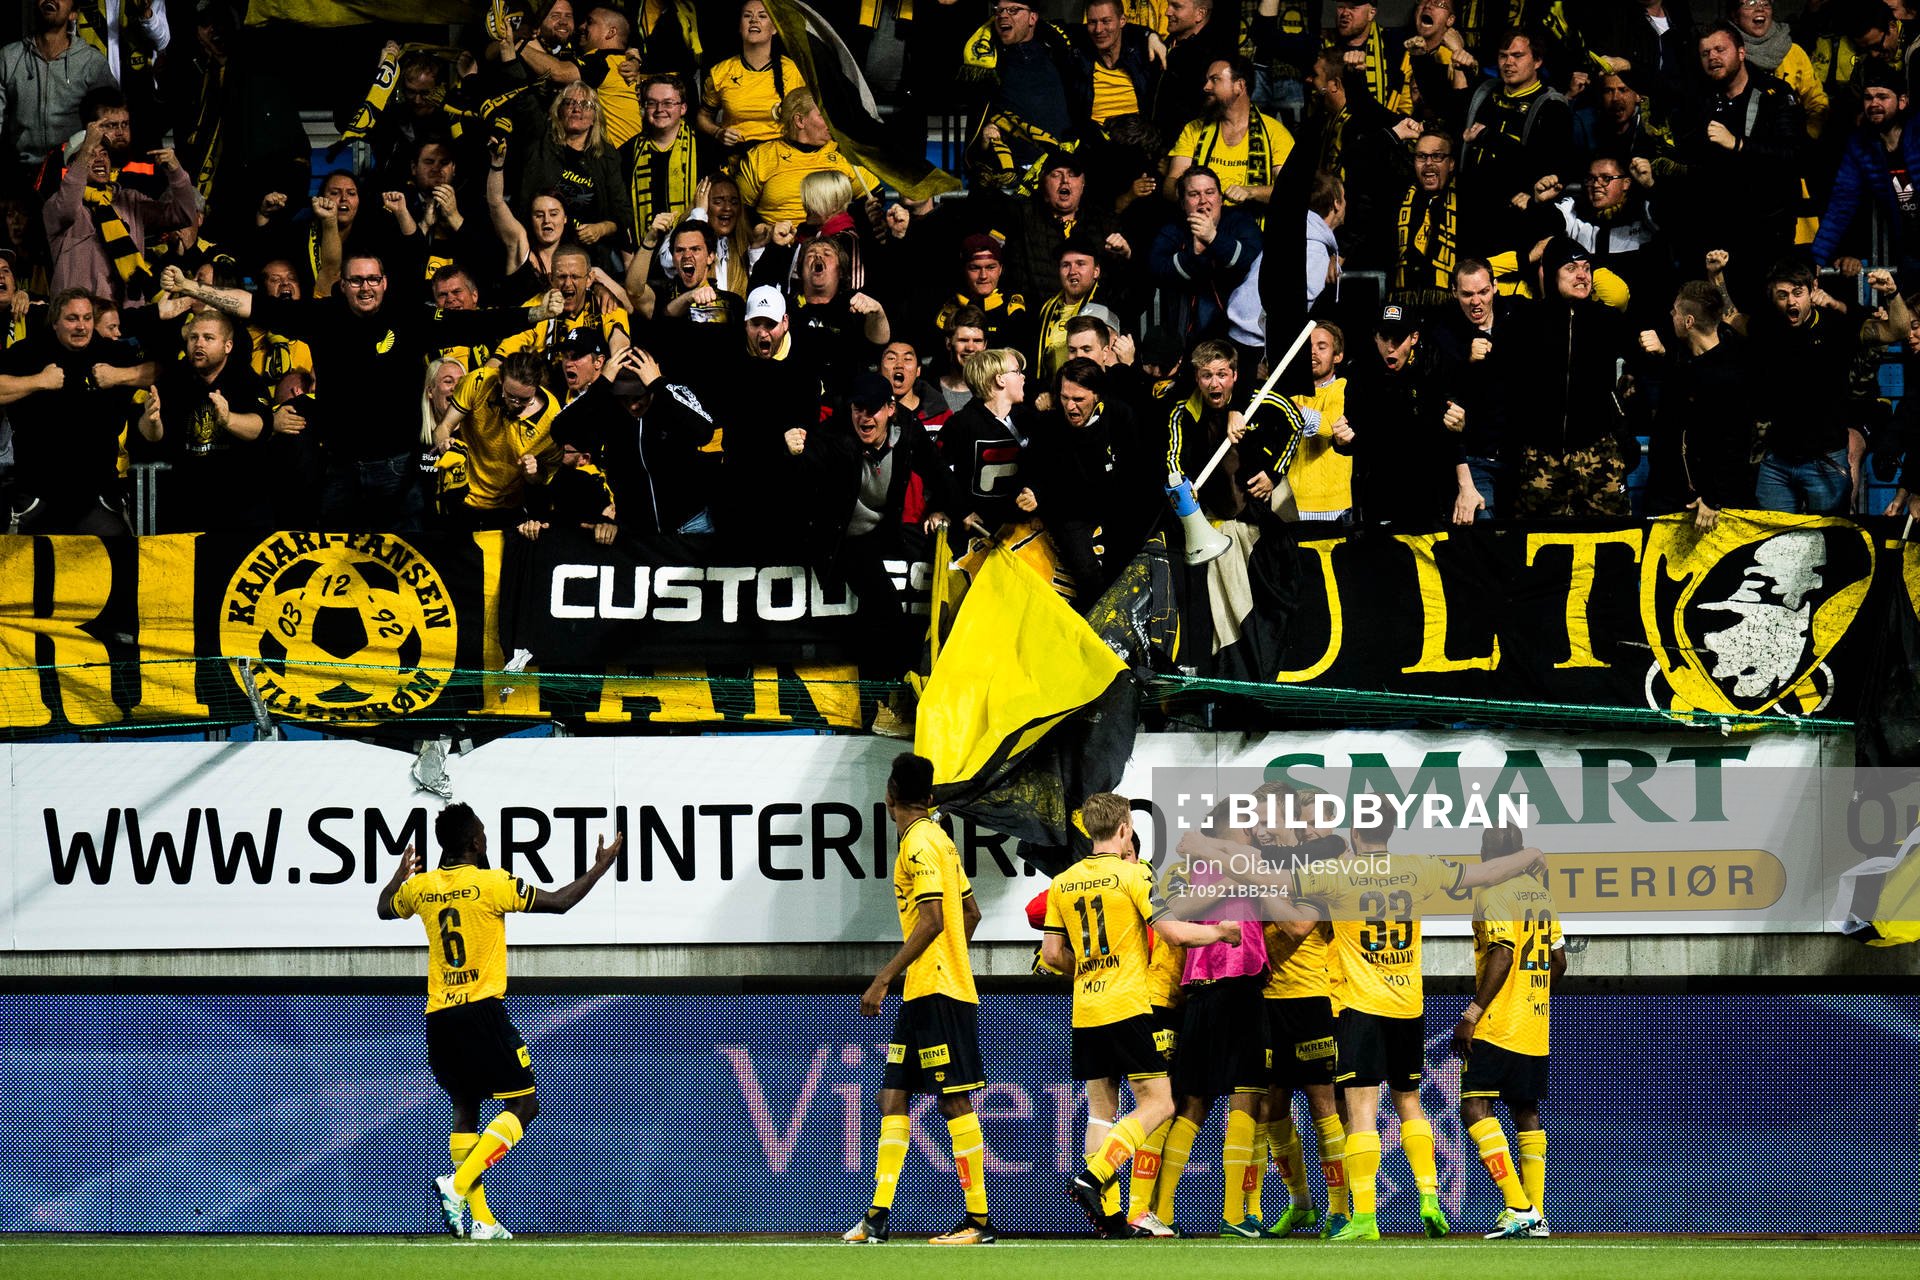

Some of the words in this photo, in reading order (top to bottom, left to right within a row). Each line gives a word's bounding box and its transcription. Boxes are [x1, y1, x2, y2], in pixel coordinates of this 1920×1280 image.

[1263, 746, 1748, 826] SMART
[438, 907, 467, 968] 6
[1074, 894, 1110, 958] 11
[1359, 889, 1413, 952] 33
[1519, 908, 1552, 971] 23
